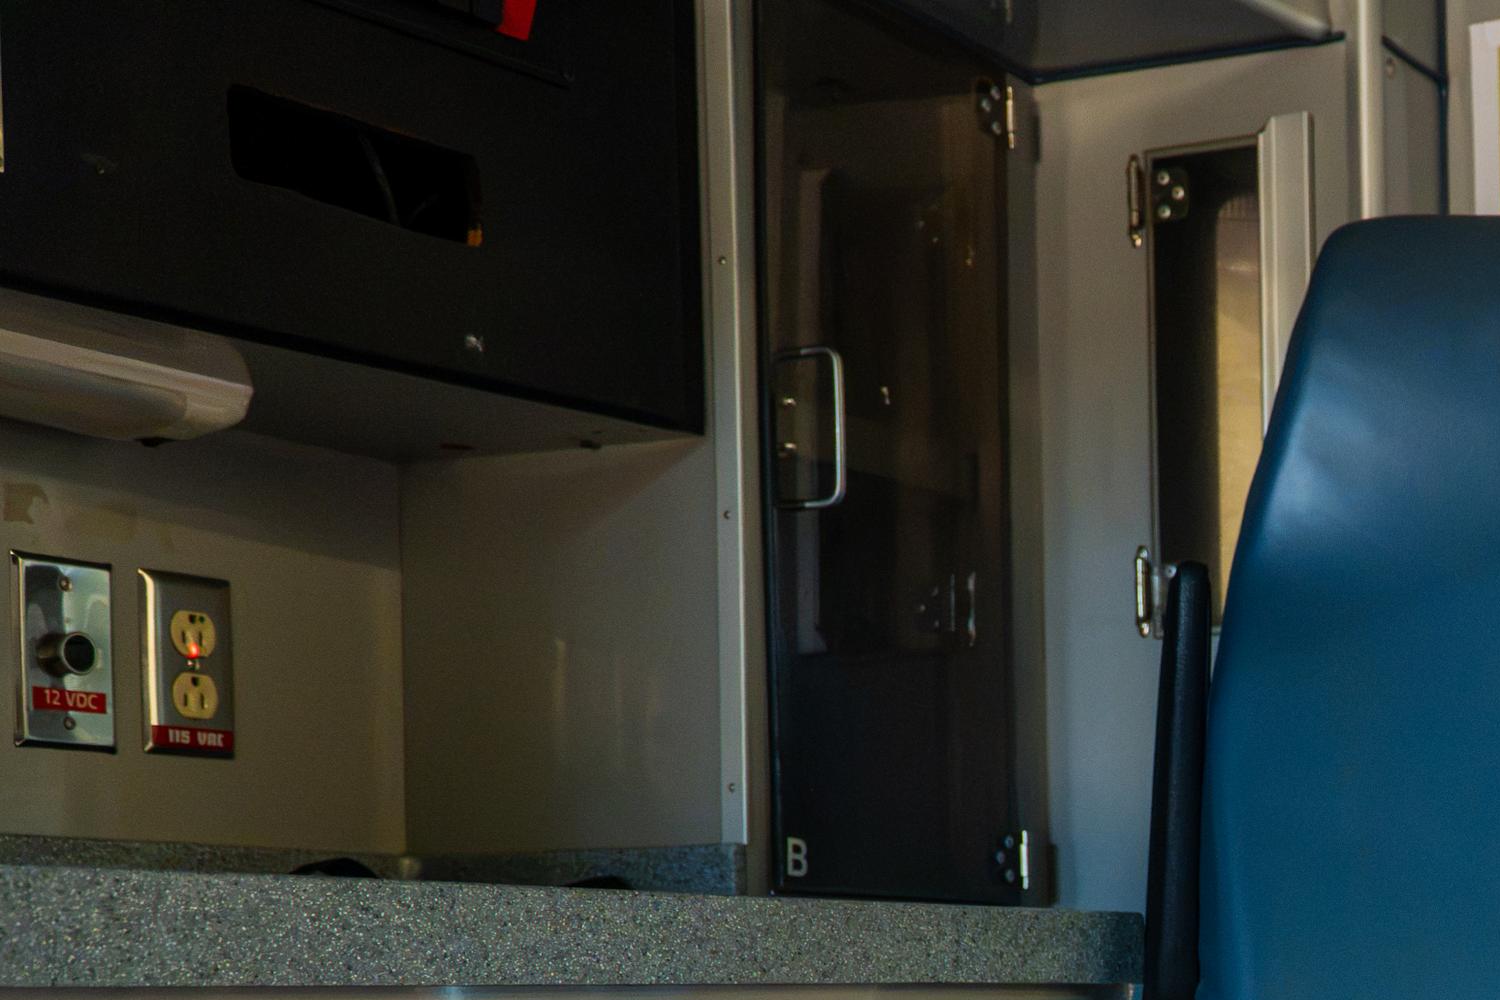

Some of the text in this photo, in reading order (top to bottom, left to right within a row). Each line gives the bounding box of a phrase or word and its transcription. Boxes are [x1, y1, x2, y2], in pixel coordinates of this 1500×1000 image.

[43, 689, 99, 710] 12 VDC
[168, 728, 225, 748] 115 VAC
[786, 836, 809, 878] B
